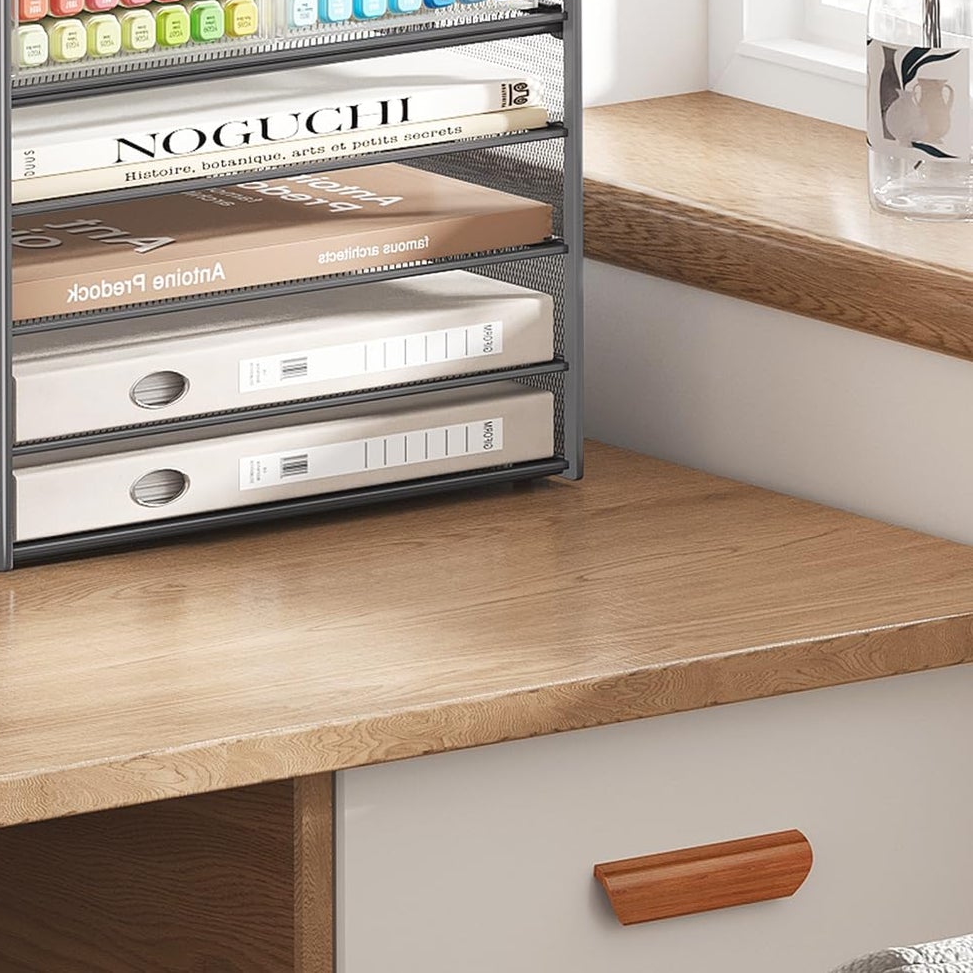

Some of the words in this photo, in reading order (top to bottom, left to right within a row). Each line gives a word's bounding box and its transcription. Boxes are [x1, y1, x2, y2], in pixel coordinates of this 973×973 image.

[112, 96, 412, 164] NOGUCHI
[291, 145, 326, 158] arts
[330, 142, 347, 153] et
[352, 135, 398, 150] petits
[403, 126, 463, 142] secrets
